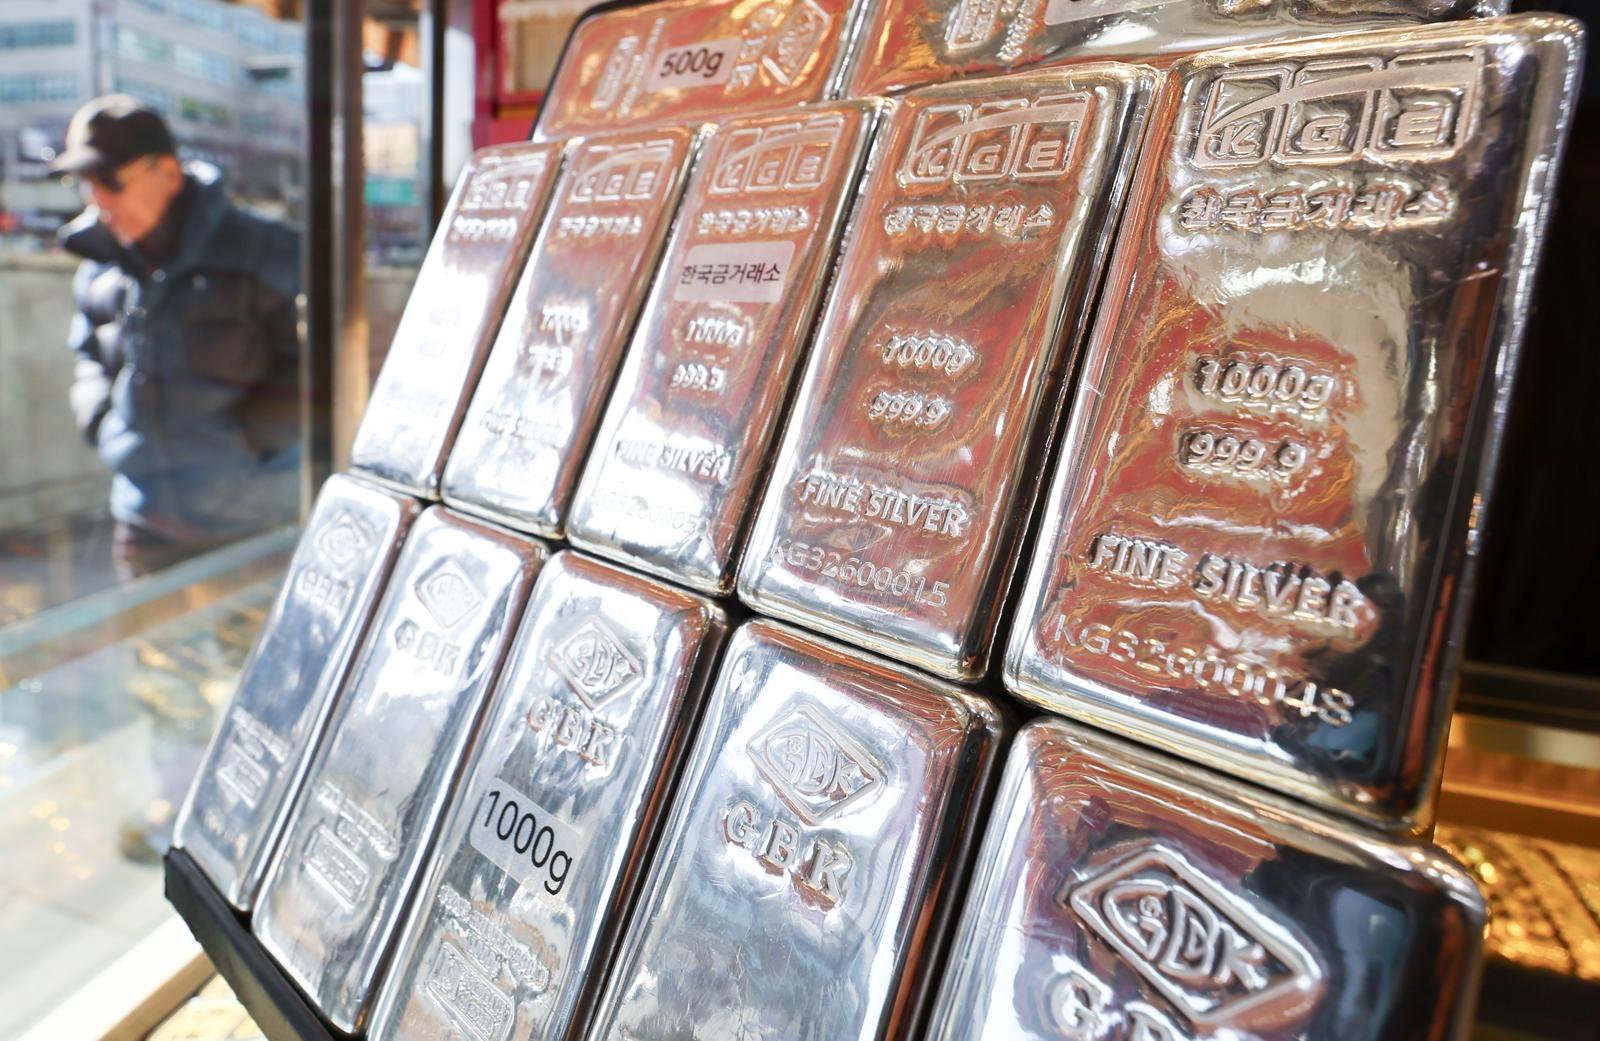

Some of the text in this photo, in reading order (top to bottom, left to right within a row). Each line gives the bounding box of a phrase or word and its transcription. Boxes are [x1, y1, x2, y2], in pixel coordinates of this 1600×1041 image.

[659, 48, 723, 77] 500g
[883, 202, 1056, 236] 한국금거래소
[680, 262, 781, 285] 한국금거래소
[685, 317, 744, 349] 1000g
[882, 335, 976, 377] 1000g
[868, 392, 950, 425] 999.9
[1197, 357, 1336, 410] 1000g
[800, 472, 970, 537] FINE SILVER
[770, 537, 950, 609] KG32600015
[1090, 532, 1370, 630] FINE SILVER
[527, 693, 617, 767] GBK
[483, 789, 574, 896] 1000g
[721, 800, 854, 910] GBK
